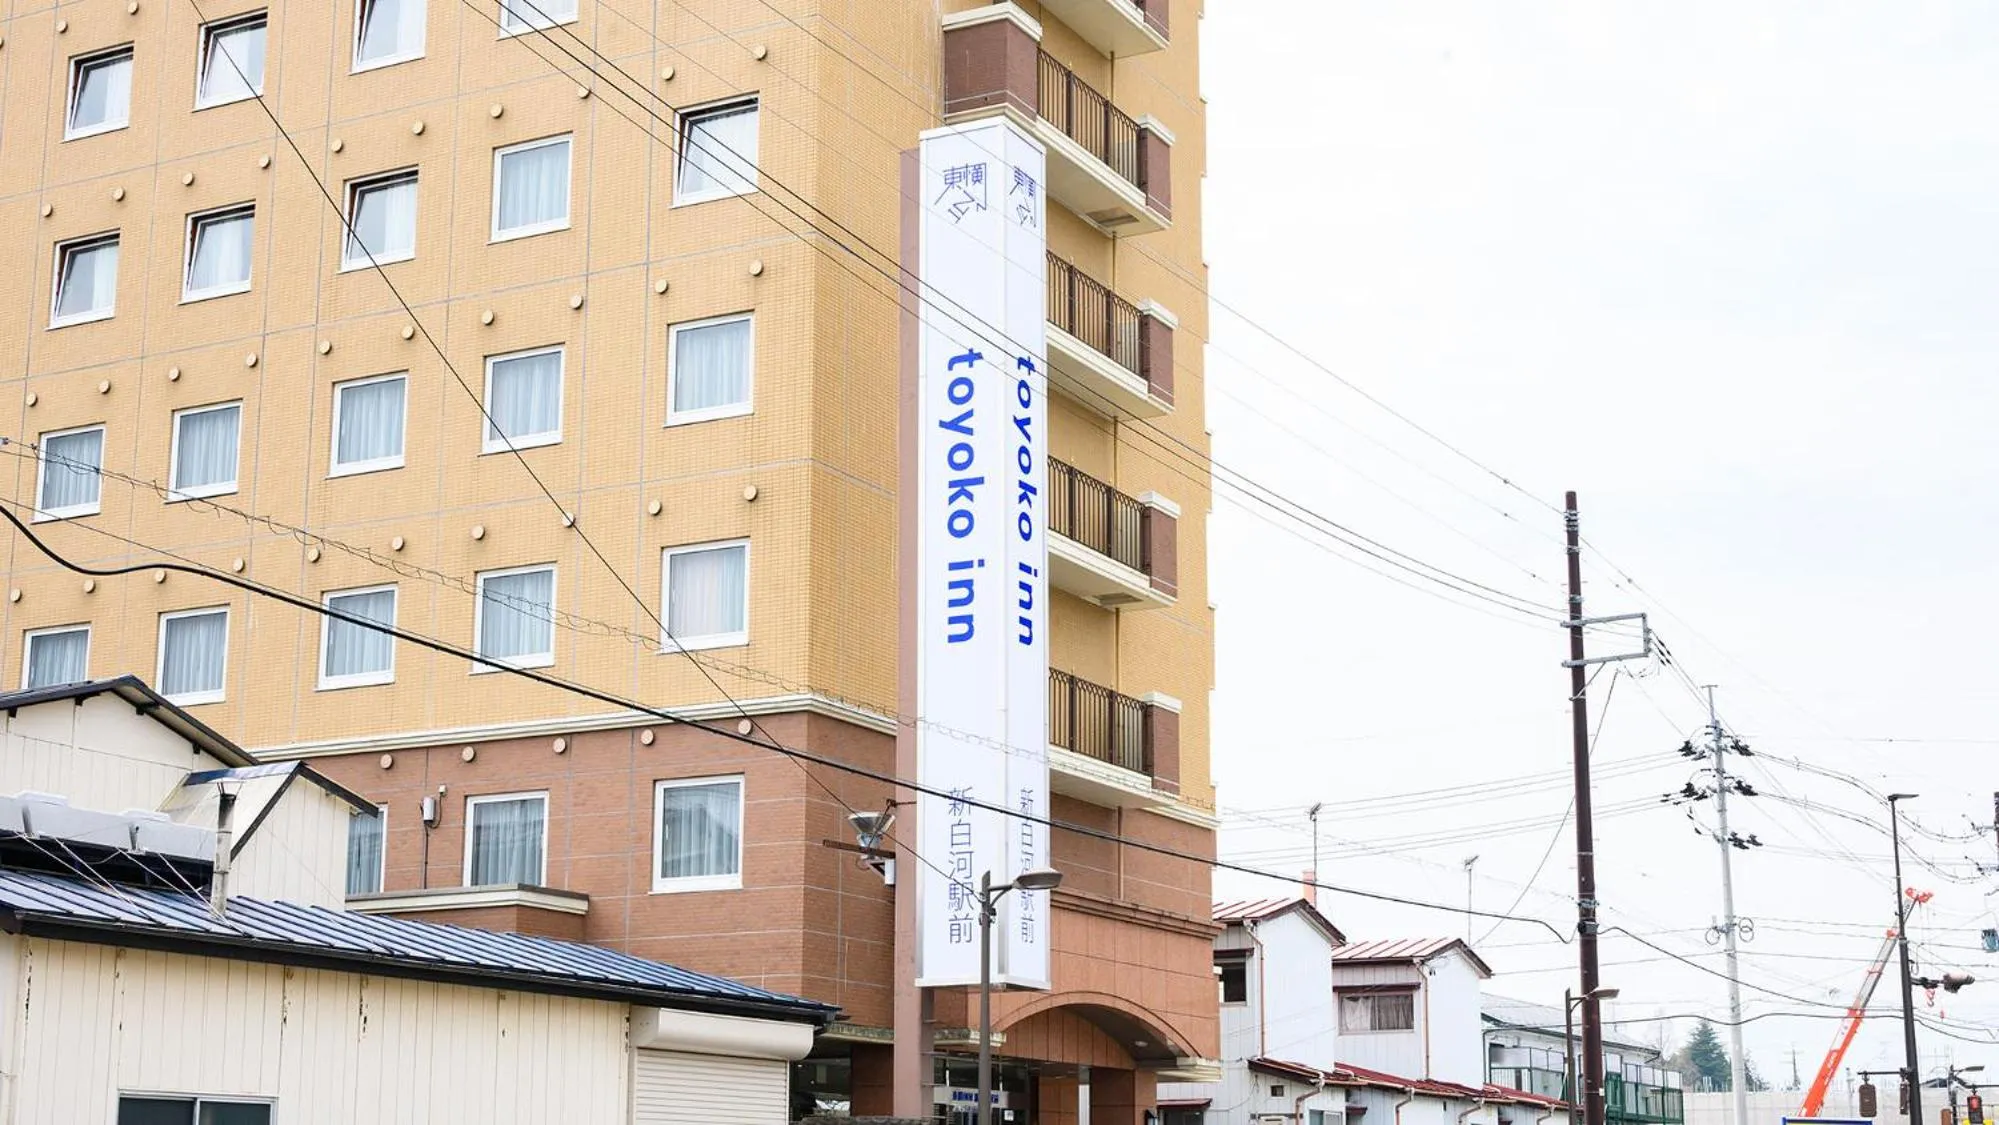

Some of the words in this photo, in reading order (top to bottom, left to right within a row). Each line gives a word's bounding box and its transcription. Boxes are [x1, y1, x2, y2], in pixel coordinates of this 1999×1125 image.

[938, 348, 984, 538] toyoko
[1013, 356, 1037, 541] toyoko
[947, 559, 985, 643] inn
[1018, 562, 1038, 646] inn
[948, 786, 974, 944] 新白河駅前
